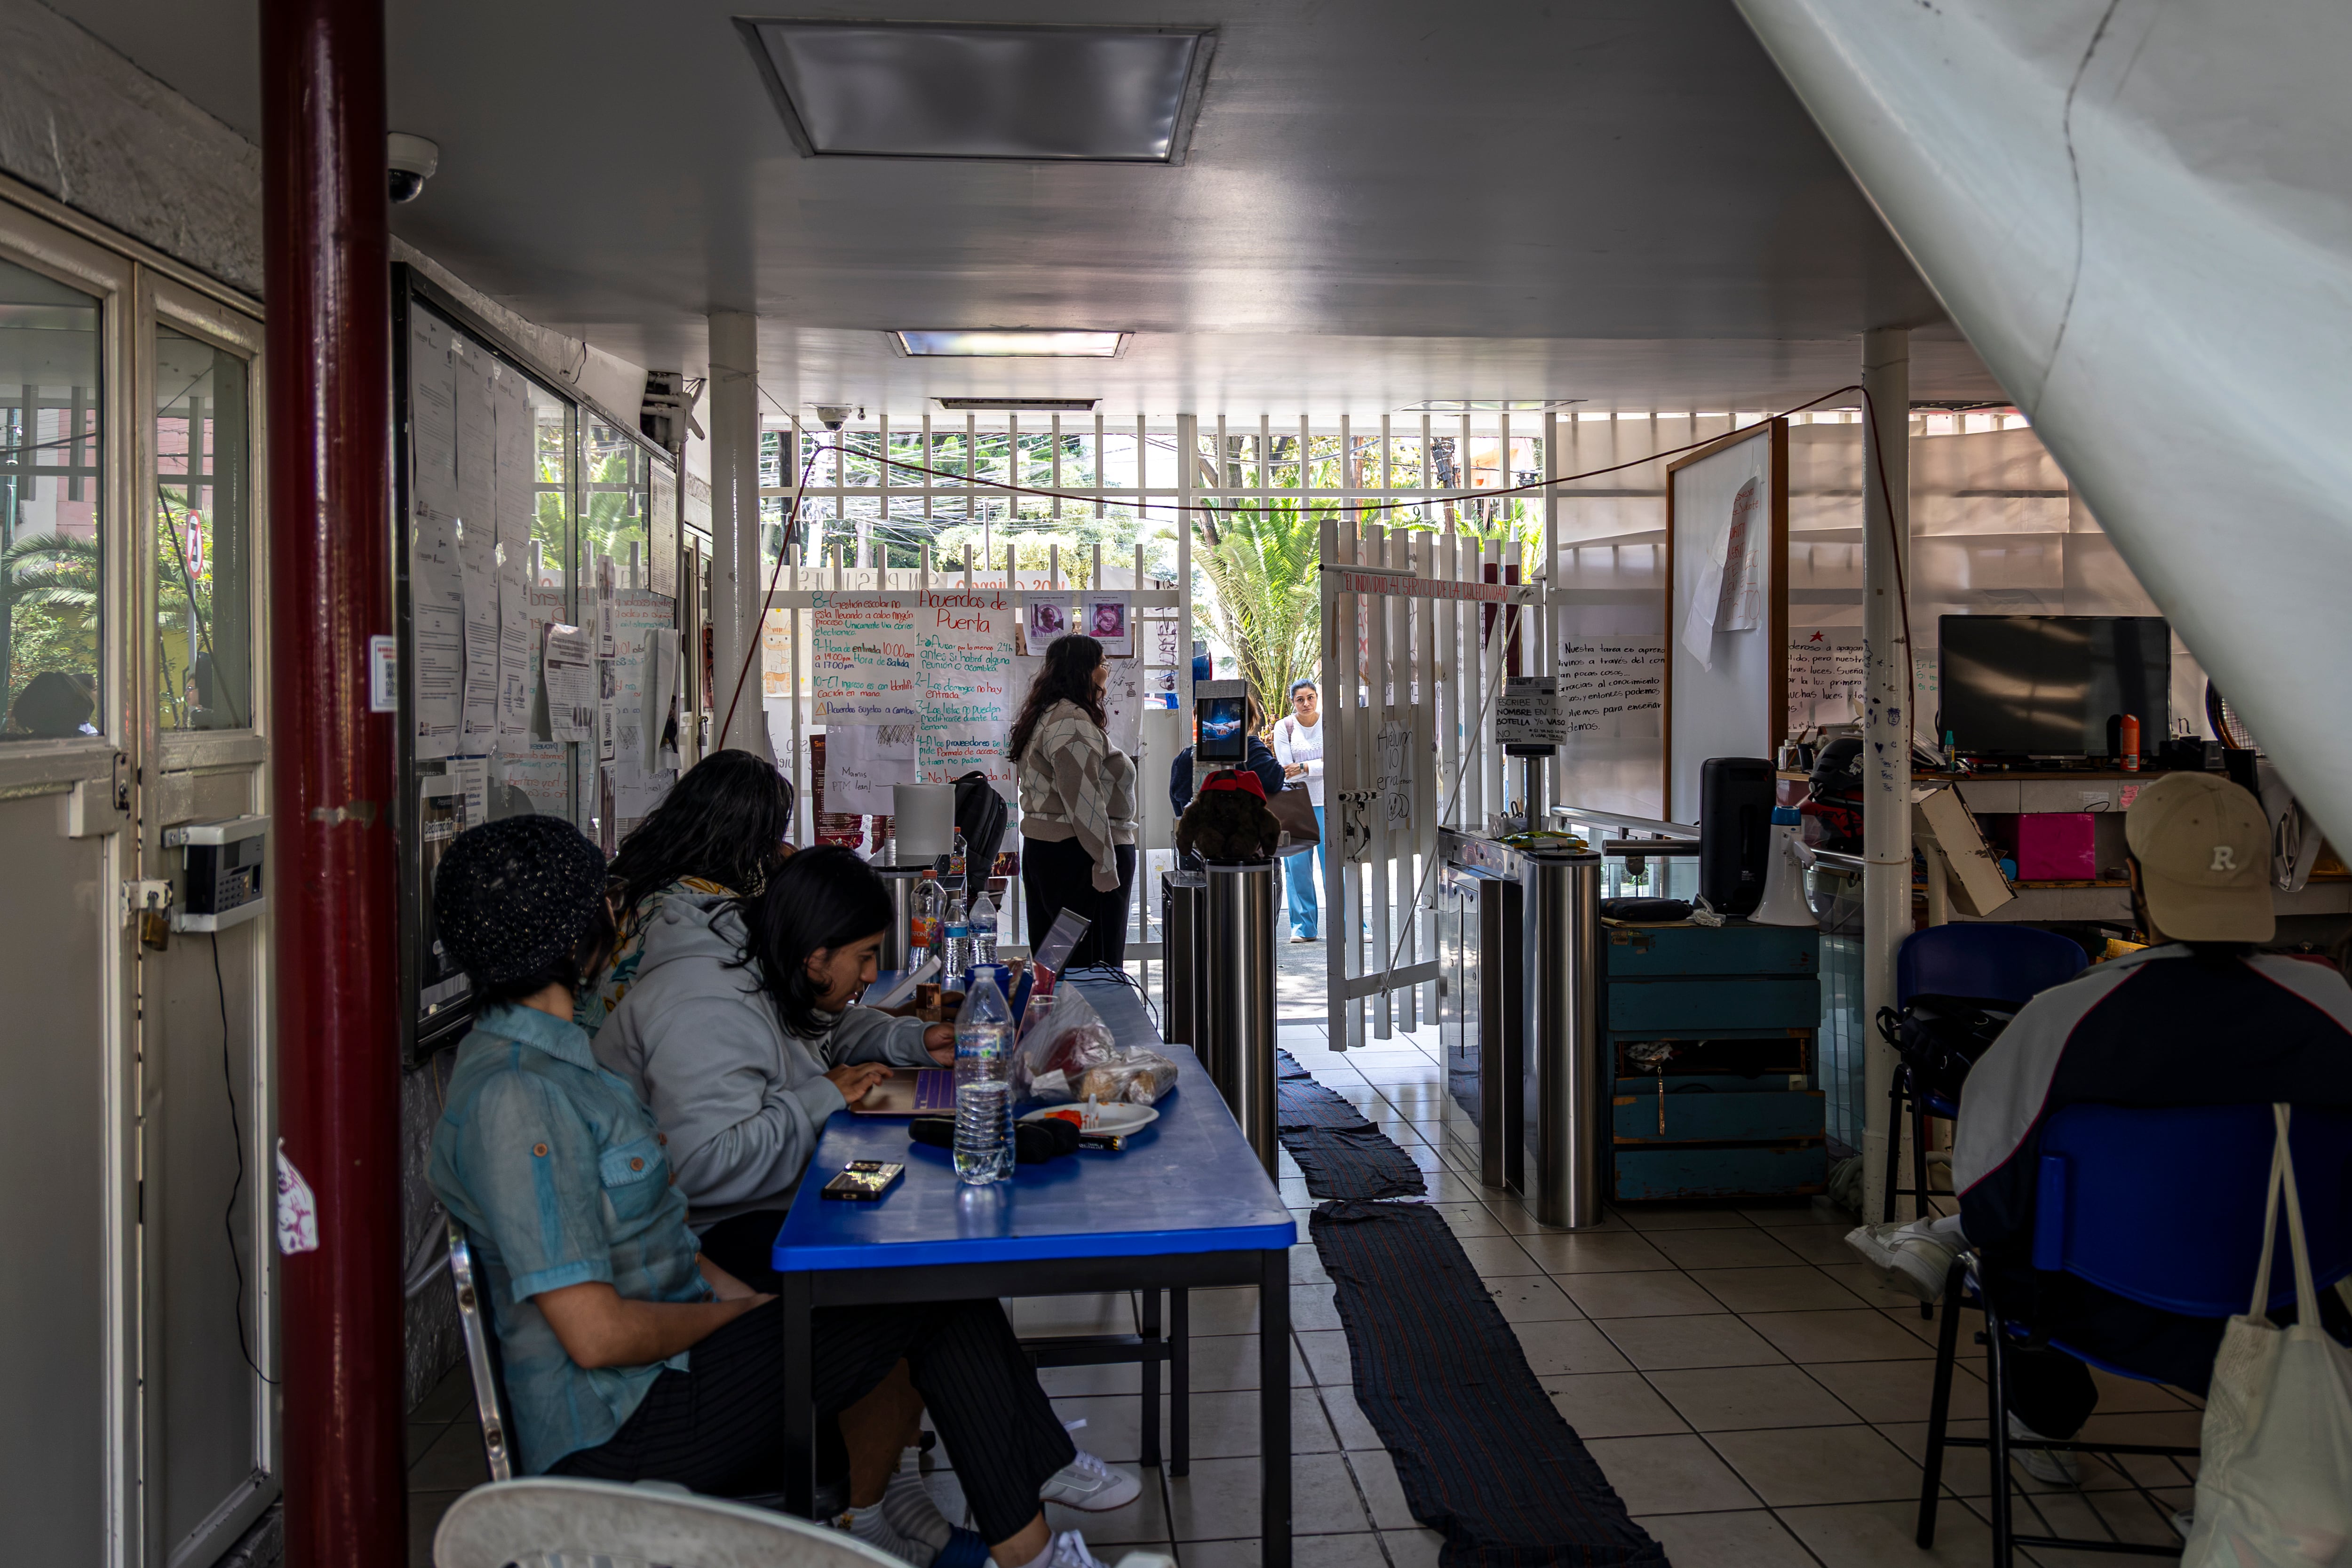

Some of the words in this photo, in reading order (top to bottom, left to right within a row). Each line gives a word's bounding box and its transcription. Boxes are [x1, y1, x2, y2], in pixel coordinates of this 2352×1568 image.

[1726, 562, 1738, 580] TE
[1355, 574, 1388, 594] INDIVIDUO
[1389, 576, 1400, 595] AL
[1402, 578, 1435, 597] SERVICIO
[1437, 581, 1446, 597] DE
[1449, 581, 1460, 598] LA
[1727, 580, 1738, 595] EN
[863, 595, 890, 608] escolar
[891, 600, 901, 609] no
[920, 588, 985, 609] Acuerdos
[990, 591, 1009, 611] de
[815, 608, 832, 620] esta
[835, 608, 863, 620] llevando
[873, 609, 891, 619] cabo
[892, 610, 914, 624] ningún
[937, 608, 990, 633] Puerta
[843, 642, 851, 653] de
[852, 642, 881, 654] entrada
[967, 643, 973, 651] lo
[997, 642, 1013, 653] 24h
[1565, 642, 1595, 654] Nuestra
[1599, 643, 1621, 653] tarea
[1789, 639, 1821, 652] deroso
[854, 653, 874, 665] Hora
[876, 655, 885, 666] de
[920, 649, 947, 662] antes
[959, 651, 983, 663] habrá
[985, 652, 1010, 666] alguna
[922, 659, 953, 669] reunión
[1600, 656, 1628, 665] través
[1812, 655, 1832, 665] pero
[1574, 669, 1598, 678] pocas
[1836, 666, 1864, 675] Sueña
[842, 680, 864, 691] ingreso
[943, 677, 976, 695] domingos
[977, 685, 985, 693] no
[986, 681, 1002, 695] hay
[1598, 679, 1606, 688] al
[1609, 677, 1661, 686] conocimiento
[1801, 676, 1808, 685] la
[1813, 677, 1825, 685] luz
[1830, 678, 1862, 689] primera
[1588, 690, 1623, 700] entonces
[1625, 687, 1661, 699] podemos
[1822, 688, 1843, 700] luces
[1848, 693, 1852, 702] y
[827, 700, 856, 715] Acuerdos
[858, 704, 882, 716] sujetos
[943, 702, 960, 714] listas
[962, 705, 971, 714] no
[972, 701, 1001, 716] pueden
[1569, 709, 1600, 717] lvemos
[1603, 705, 1623, 716] para
[1627, 701, 1662, 711] enseñar
[991, 713, 998, 721] la
[1497, 730, 1510, 738] NO
[934, 736, 944, 747] los
[946, 735, 990, 749] proveedores
[919, 746, 935, 757] pide
[964, 747, 974, 755] de
[919, 757, 926, 766] lo
[927, 757, 945, 766] traen
[842, 766, 867, 778] Mamis
[1001, 768, 1011, 781] al
[425, 817, 453, 835] Declaración
[2210, 846, 2237, 871] R
